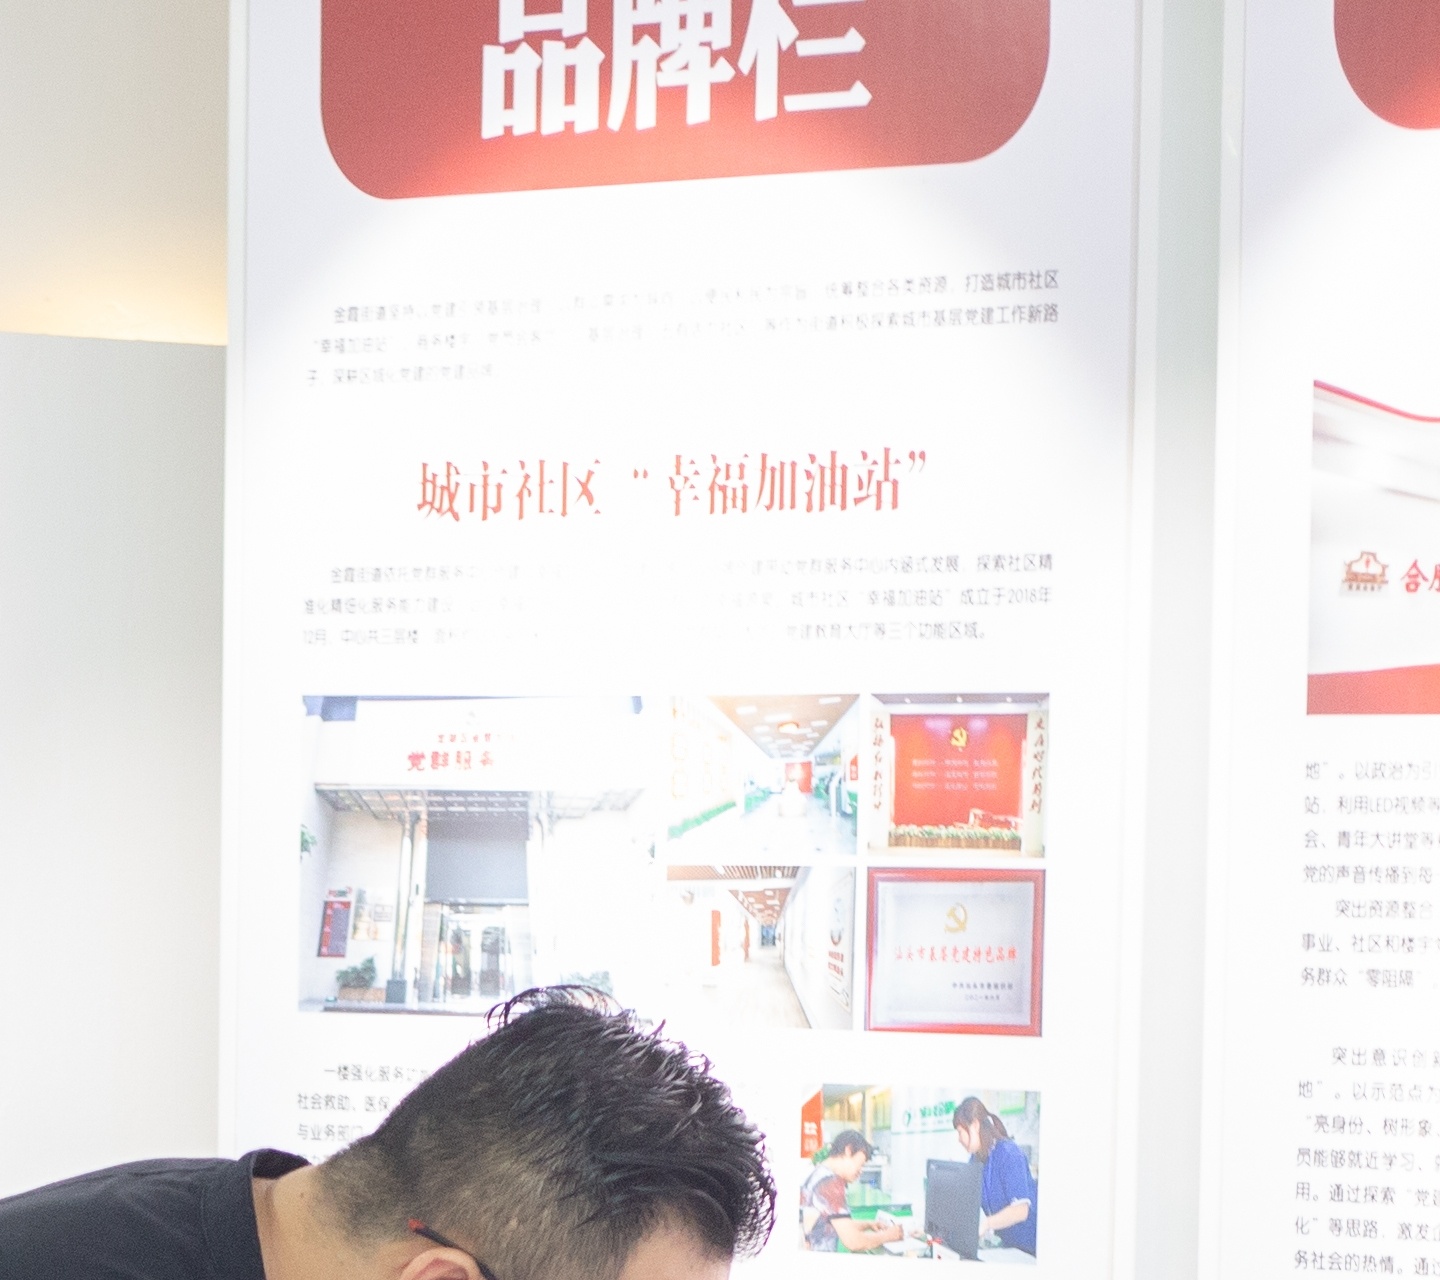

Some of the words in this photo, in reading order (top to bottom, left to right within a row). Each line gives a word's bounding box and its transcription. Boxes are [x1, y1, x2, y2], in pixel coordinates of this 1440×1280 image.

[480, 0, 872, 140] 品牌栏
[415, 447, 927, 523] 城市社区“幸福加油站”
